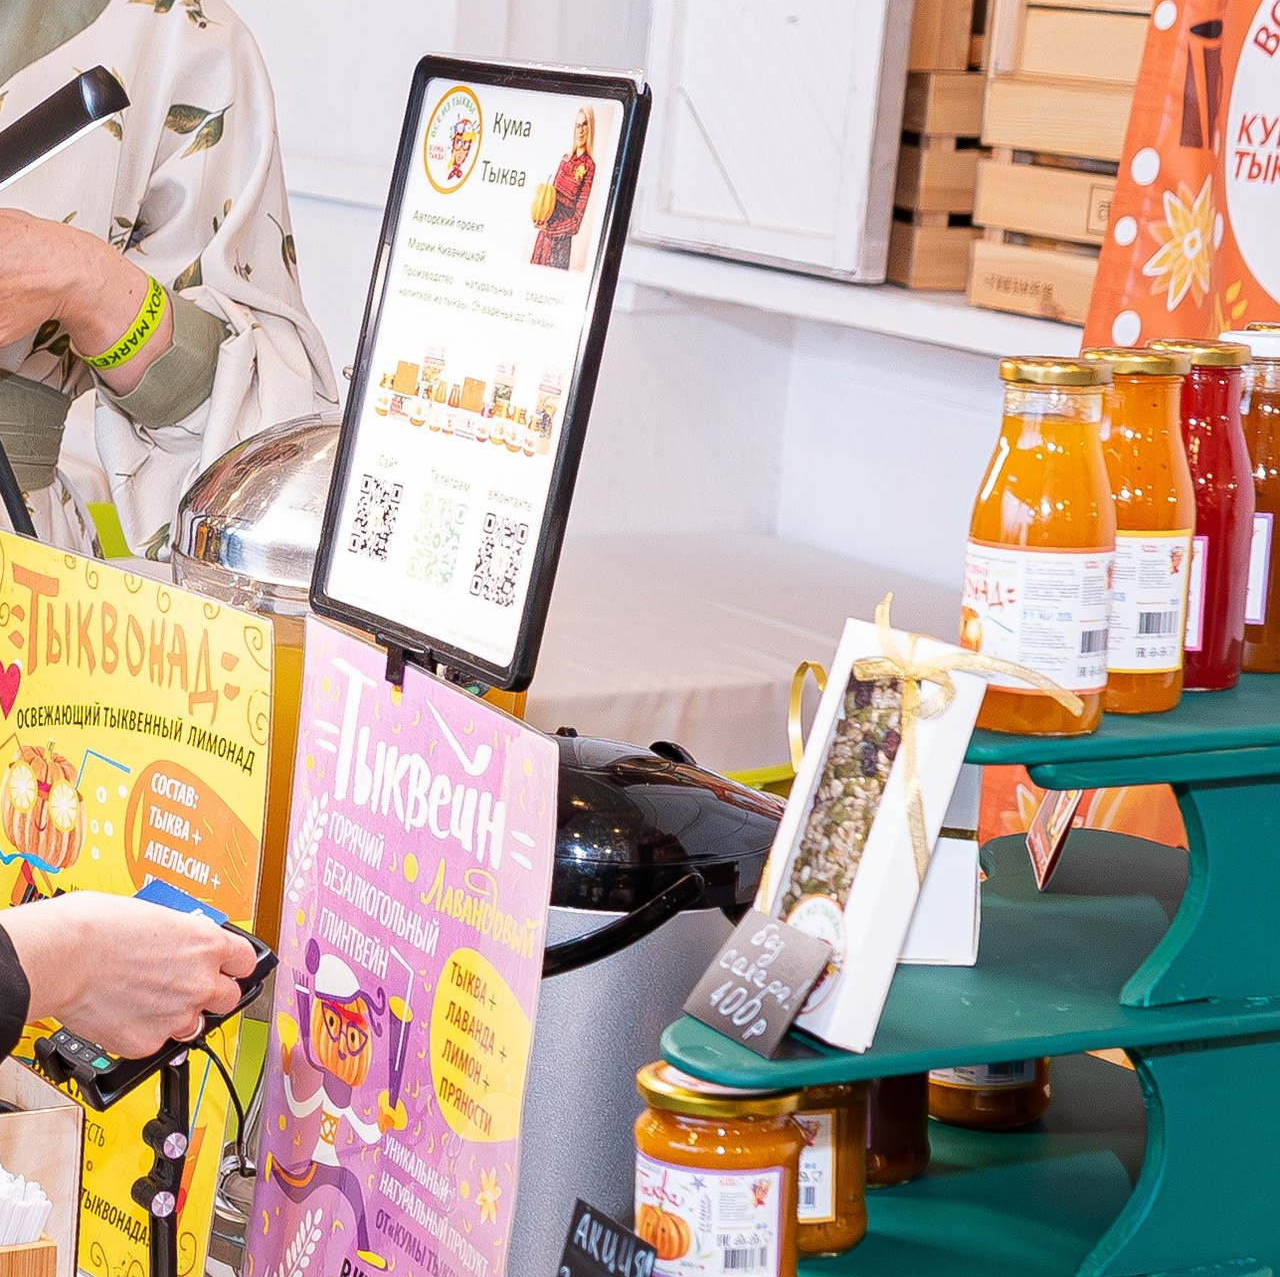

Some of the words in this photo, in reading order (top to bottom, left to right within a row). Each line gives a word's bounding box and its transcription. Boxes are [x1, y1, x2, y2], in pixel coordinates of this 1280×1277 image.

[493, 112, 532, 140] Кума
[1237, 114, 1280, 146] КУ
[482, 160, 526, 187] Тыква
[413, 210, 455, 228] Авторский
[456, 219, 485, 233] проект
[17, 701, 101, 730] ОСВЕЖАЮЩИЙ
[103, 705, 183, 743] ТЫКВЕННЫЙ
[187, 725, 256, 776] ЛИМОНАД
[150, 772, 200, 810] СОСТАВ:
[148, 805, 191, 842] ТЫКВА
[327, 809, 385, 871] ГОРЯЧИЙ
[144, 839, 211, 886] АПЕЛЬСИН
[322, 855, 441, 958] БЕЗАЛКОГОЛЬНЫЙ
[318, 906, 391, 980] ГЛИНТВЕЙН
[450, 961, 487, 1005] ТЫКВА
[445, 1000, 495, 1056] ЛАВАНДА
[442, 1038, 482, 1086] ЛИМОН
[438, 1076, 492, 1137] ПРЯНОСТИ
[383, 1134, 450, 1205] УНИКАЛЬНЫЙ
[379, 1170, 449, 1244] НАТУРАЛЬНЫЙ
